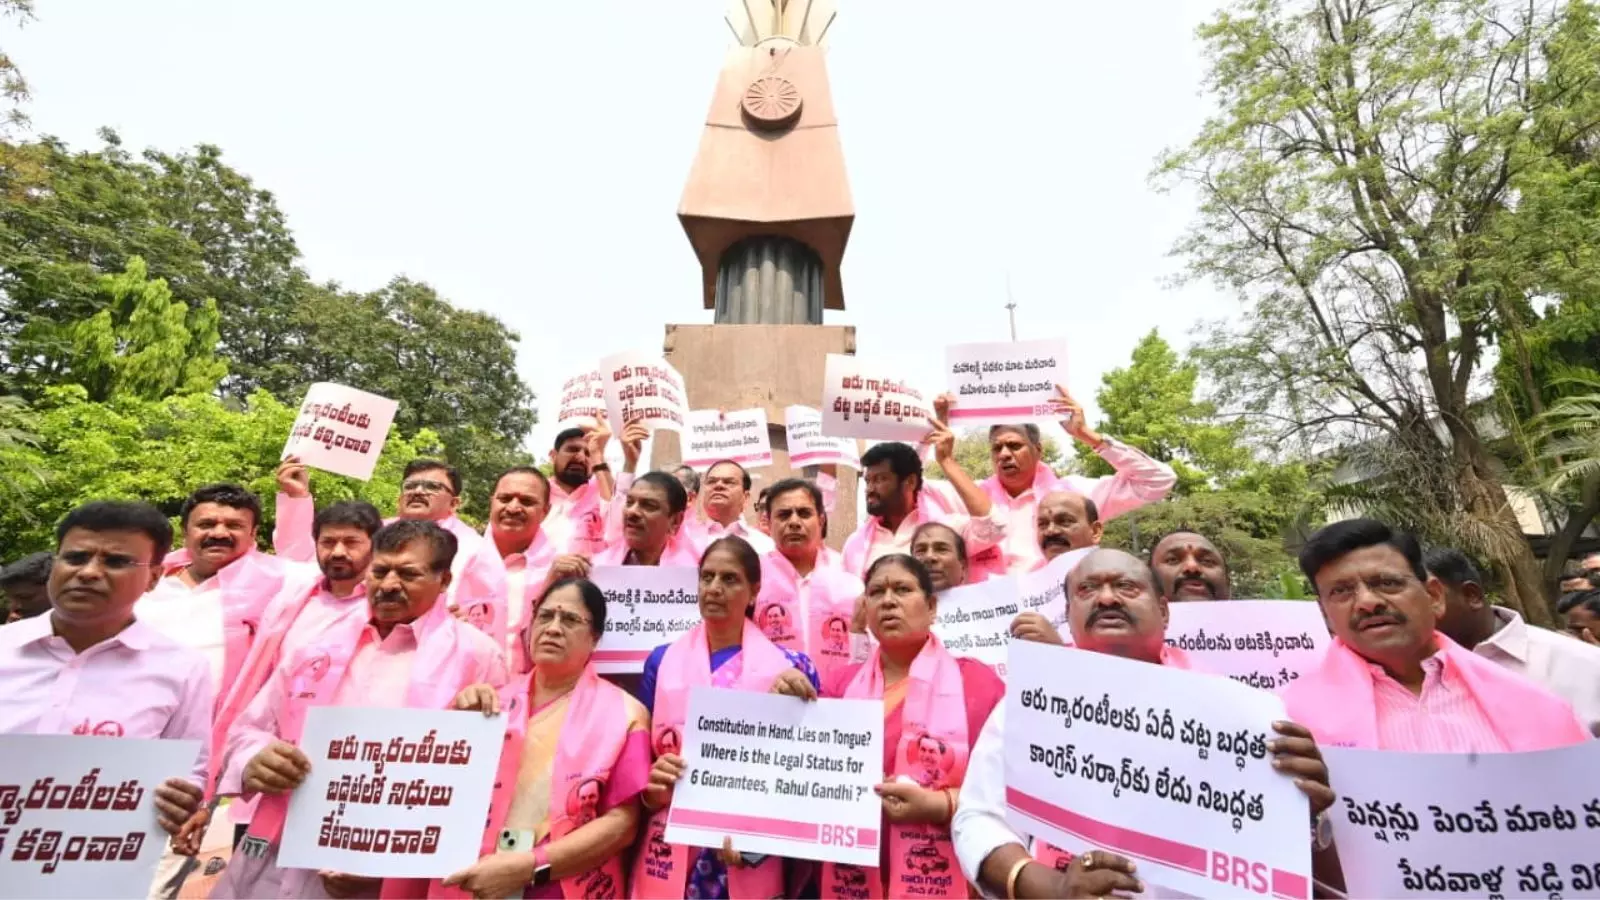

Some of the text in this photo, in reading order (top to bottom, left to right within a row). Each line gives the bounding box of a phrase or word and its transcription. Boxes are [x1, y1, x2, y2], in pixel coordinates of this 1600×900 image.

[842, 374, 864, 390] ఆరు
[1005, 360, 1024, 371] మాట
[615, 617, 641, 636] కాంగ్రెస్
[1235, 631, 1315, 658] అటకెక్కించారు
[698, 715, 756, 737] Constitution
[757, 721, 767, 738] in
[797, 726, 817, 743] Lies
[818, 731, 831, 744] on
[833, 728, 872, 750] Tongue?
[1021, 687, 1267, 771] ఆరు గ్యారంటీలకు ఏదీ చట్ట బద్ధత
[327, 729, 472, 774] ఆరు గ్యారంటీలకు
[701, 742, 864, 774] Where is the Legal Status for
[388, 778, 454, 810] నిధులు
[690, 769, 699, 785] 6
[701, 770, 769, 795] Guarantees,
[775, 778, 809, 797] Rahul
[811, 782, 853, 802] Gandhi
[1030, 743, 1077, 778] కాంగ్రెస్
[1155, 766, 1192, 804] లేదు
[1197, 781, 1265, 833] నిబద్ధత
[318, 810, 442, 855] కేటాయించాలి
[821, 824, 856, 848] BRS
[1342, 796, 1420, 843] పెన్షన్లు
[1428, 800, 1499, 833] పెంచే
[1504, 804, 1577, 832] మాట
[11, 828, 147, 874] కల్పించాలి
[1211, 851, 1269, 894] BRS
[1397, 857, 1505, 900] పేదవాళ్ల
